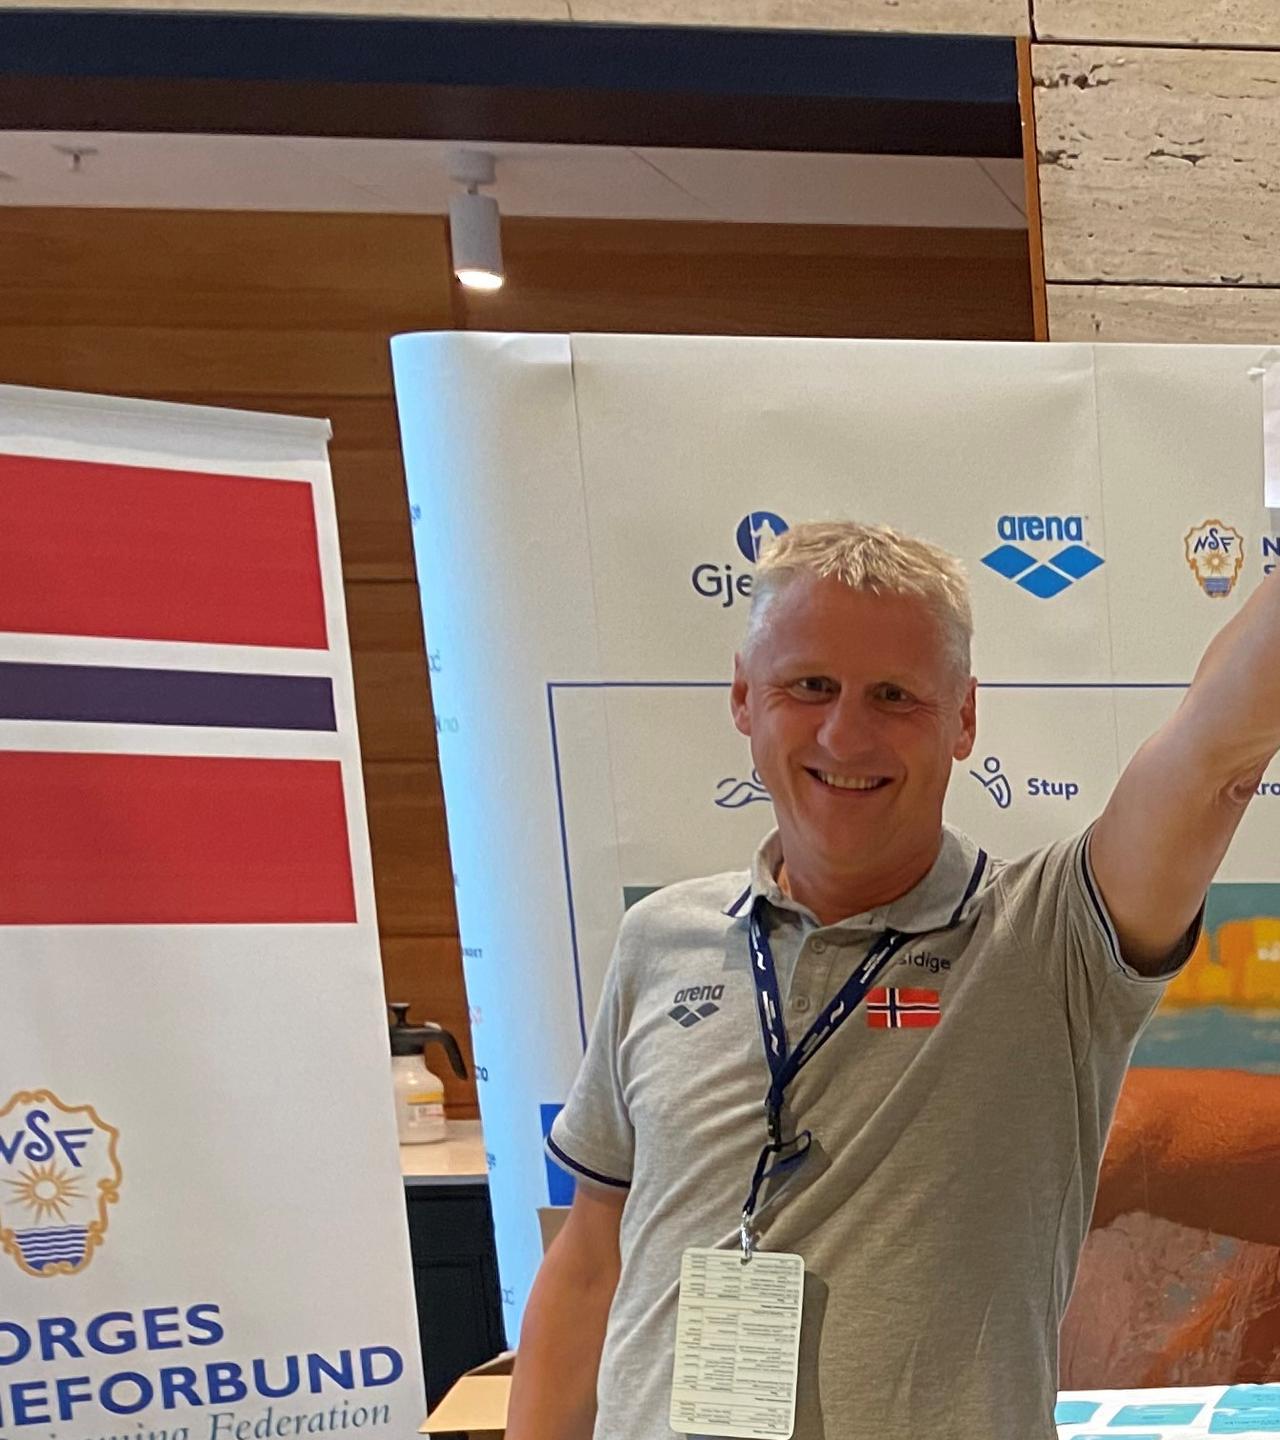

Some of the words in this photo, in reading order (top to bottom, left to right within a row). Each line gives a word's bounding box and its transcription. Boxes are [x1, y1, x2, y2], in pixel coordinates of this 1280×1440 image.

[997, 515, 1083, 541] arena
[1027, 777, 1079, 801] Stup
[673, 983, 725, 1004] arena
[0, 1303, 224, 1366] ORGES
